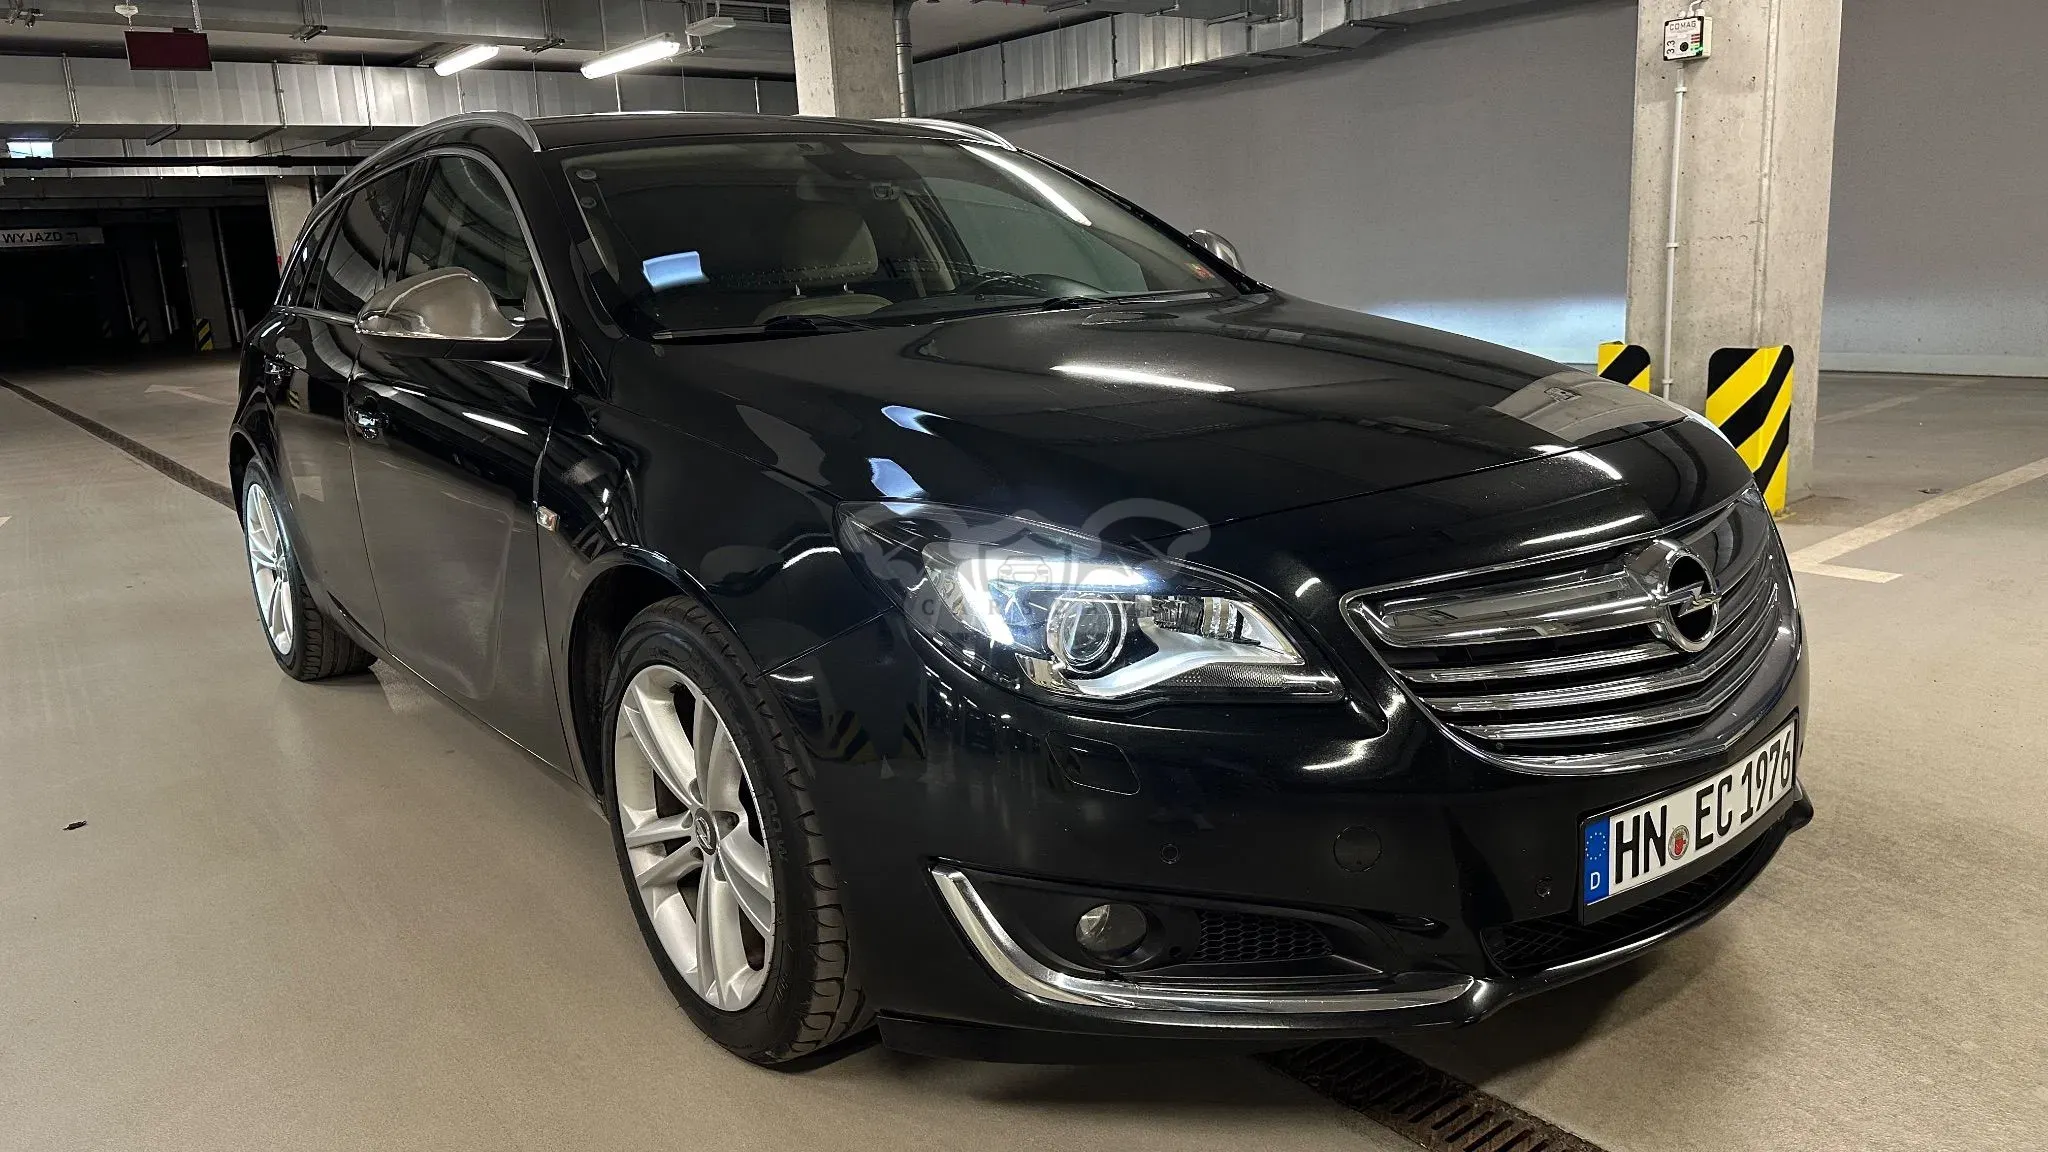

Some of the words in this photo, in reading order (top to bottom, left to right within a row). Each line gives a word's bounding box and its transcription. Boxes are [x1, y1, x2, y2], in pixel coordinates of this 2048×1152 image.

[1670, 20, 1696, 31] COMAG
[1, 231, 63, 243] WYJAZD
[1615, 804, 1667, 885] HN
[1695, 774, 1733, 852] EC
[1740, 729, 1792, 824] 1976
[1590, 872, 1600, 891] D
